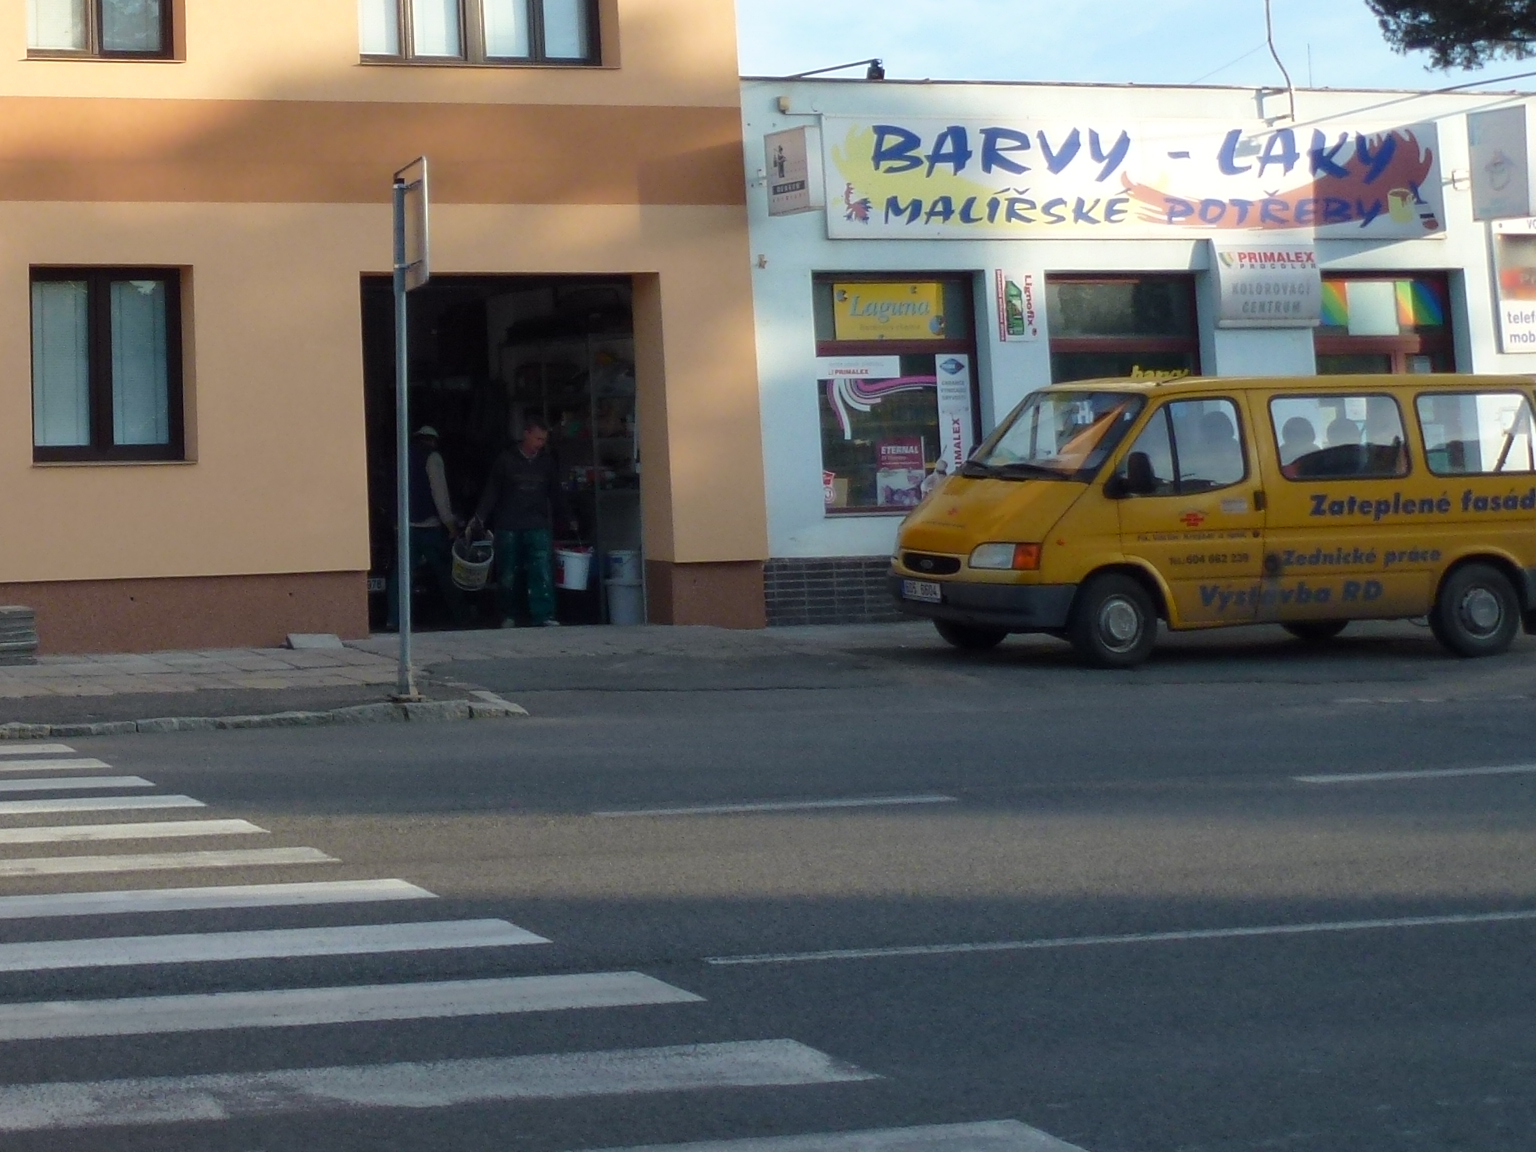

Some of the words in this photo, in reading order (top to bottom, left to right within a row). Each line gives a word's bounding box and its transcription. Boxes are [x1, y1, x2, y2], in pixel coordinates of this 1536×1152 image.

[871, 125, 1131, 182] BARVY
[1167, 151, 1191, 159] -
[1217, 127, 1397, 185] LAKY
[884, 187, 1132, 225] MALÍŘSKÉ
[1164, 189, 1383, 228] POTŘEBY
[1237, 251, 1315, 263] PRIMALEX
[849, 295, 930, 323] Laguna
[1024, 275, 1035, 326] Lignofix
[1242, 301, 1301, 313] CENTRUM
[881, 446, 919, 455] ETERNAL
[952, 418, 962, 468] IMALEX
[1310, 490, 1451, 521] Zateplené
[1281, 546, 1376, 567] Zednické
[1383, 547, 1442, 568] práce
[1341, 580, 1383, 603] RD
